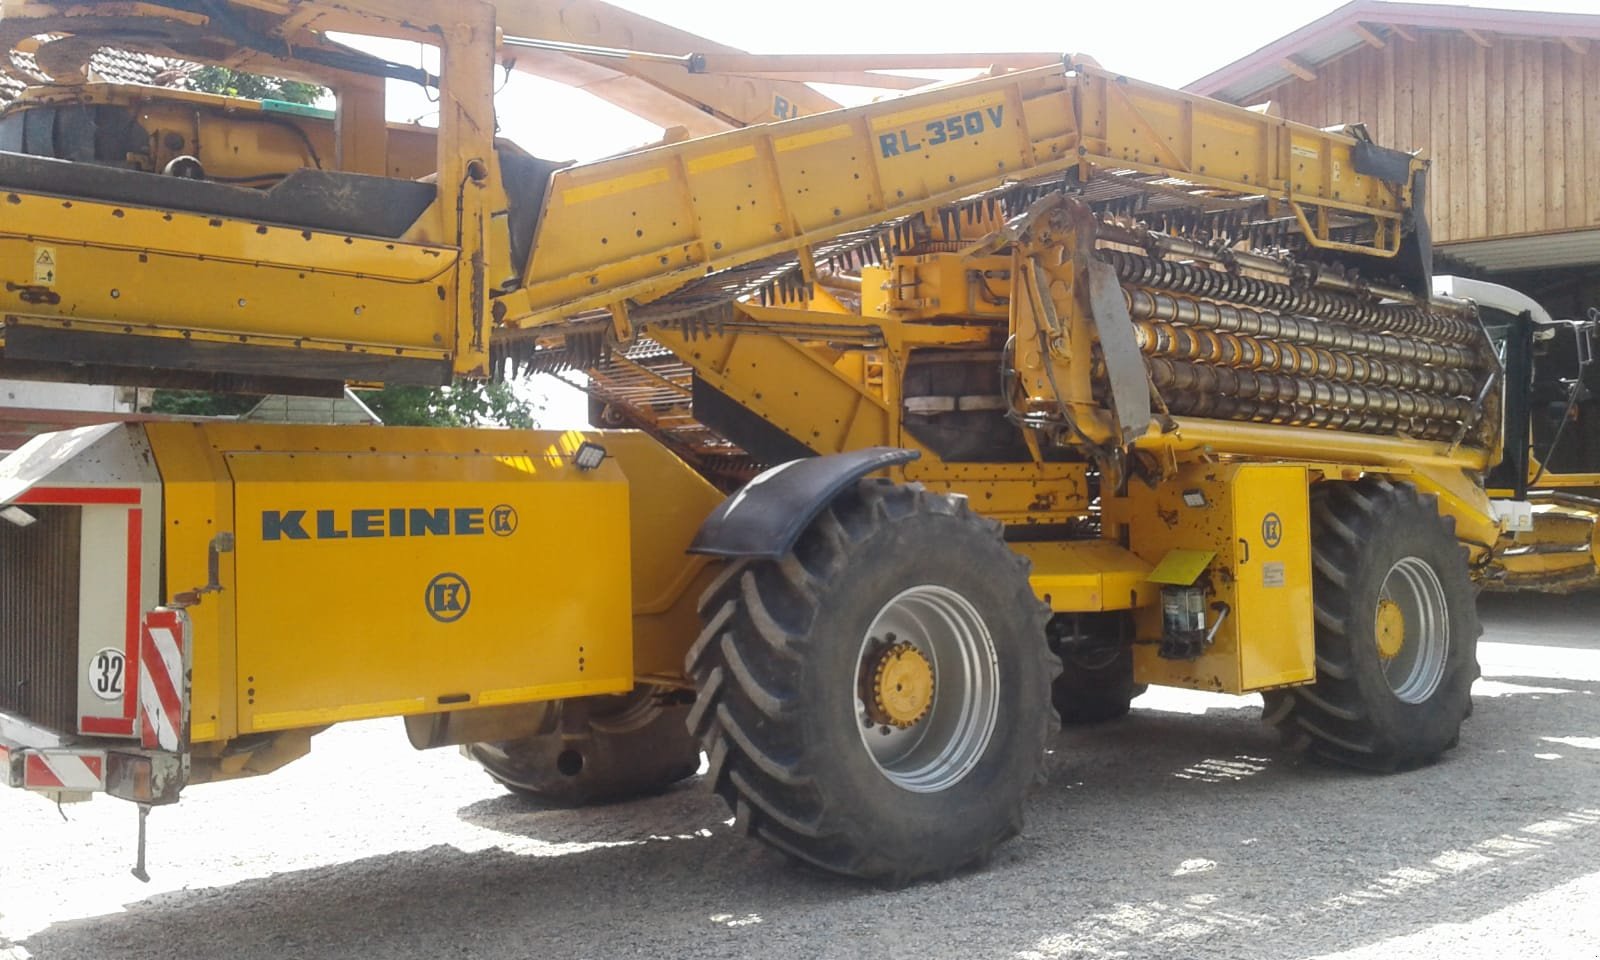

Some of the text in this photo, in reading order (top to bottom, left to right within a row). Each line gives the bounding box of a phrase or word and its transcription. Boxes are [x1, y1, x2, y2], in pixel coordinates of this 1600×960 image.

[926, 110, 984, 145] 350
[986, 105, 1003, 128] V
[262, 508, 485, 541] KLEINE
[98, 655, 123, 693] 32
